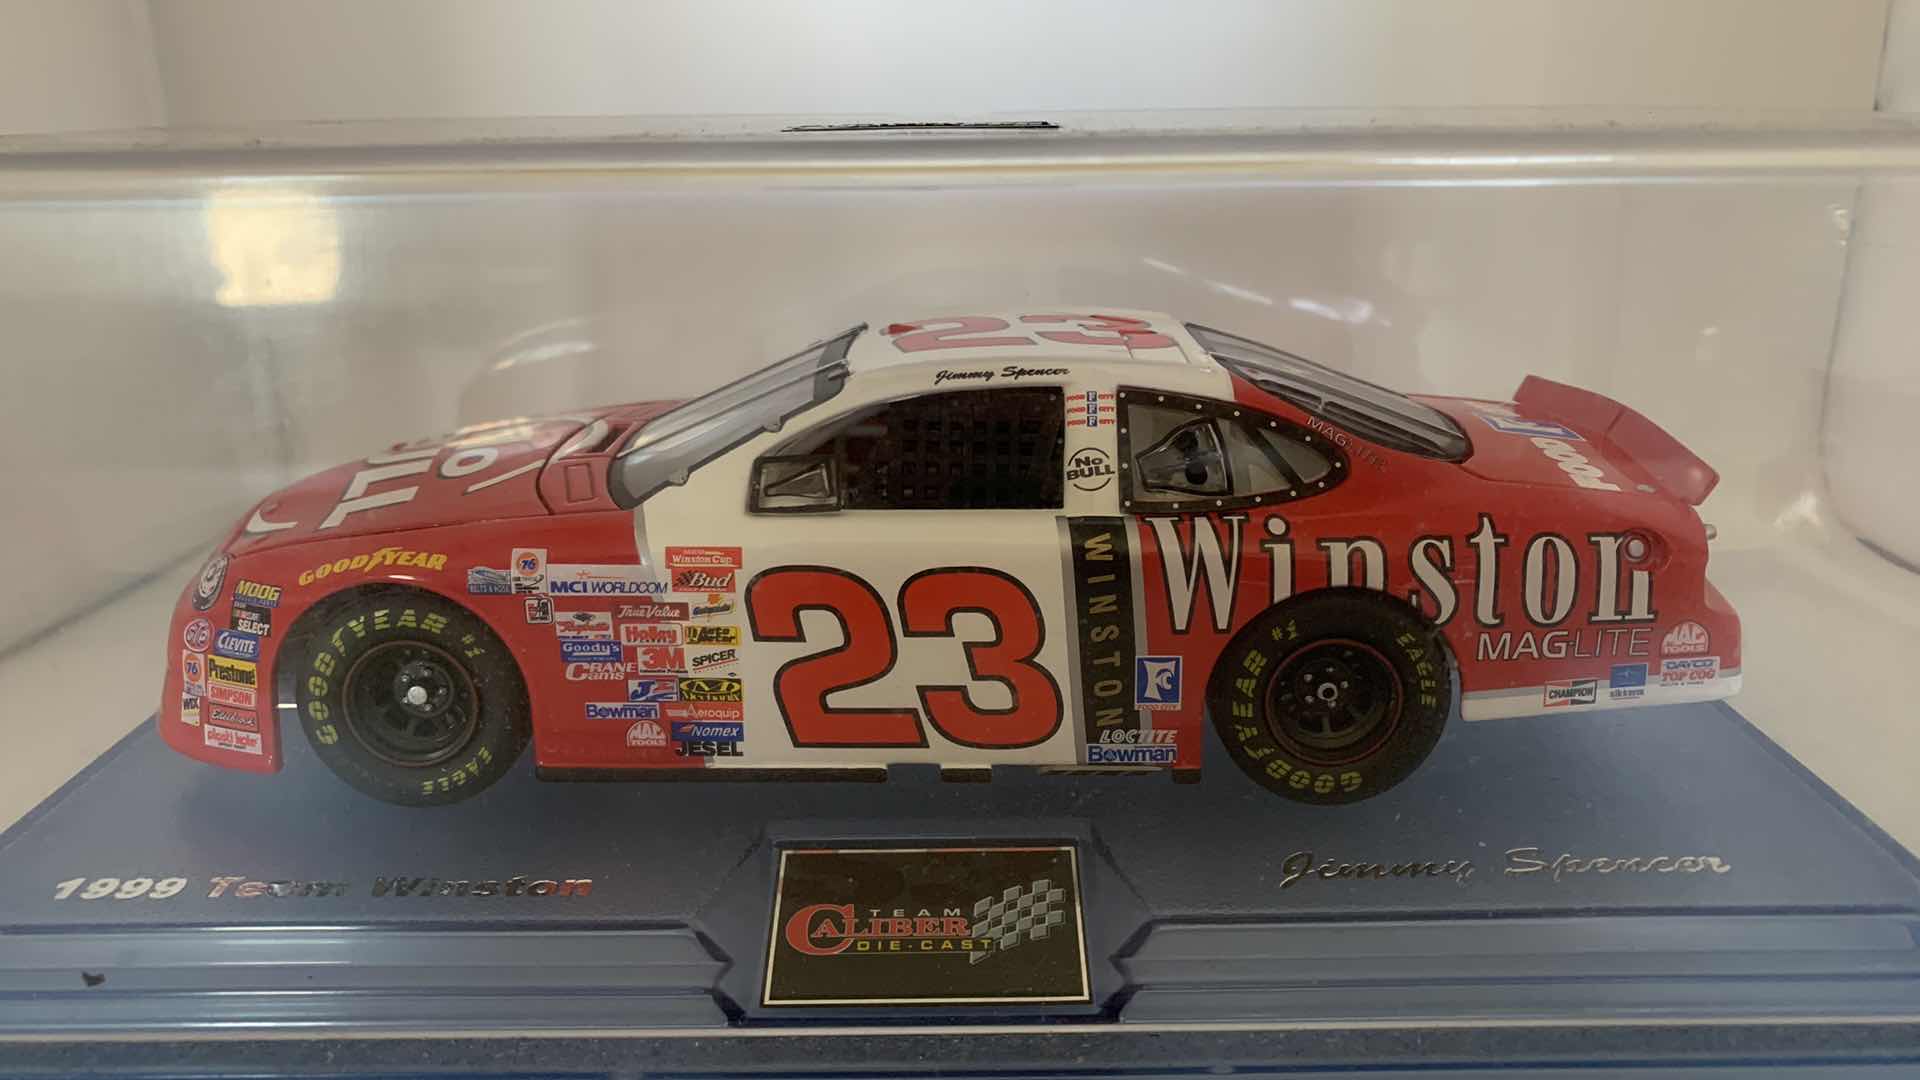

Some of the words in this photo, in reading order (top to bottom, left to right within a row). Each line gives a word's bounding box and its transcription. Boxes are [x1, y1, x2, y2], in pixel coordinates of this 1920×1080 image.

[879, 313, 1180, 353] 23
[934, 369, 995, 386] Jimmy
[1000, 365, 1072, 381] Spencer
[1074, 456, 1103, 468] No
[1066, 465, 1116, 480] BULL
[298, 547, 448, 586] GOODYEAR
[520, 558, 537, 571] 76
[672, 554, 711, 564] Winston
[688, 571, 735, 588] Bud
[1144, 511, 1658, 635] Winston
[235, 580, 282, 601] MOOG
[550, 581, 587, 593] MCI
[590, 581, 668, 594] WORLDCOM
[646, 604, 681, 618] Value
[237, 619, 270, 636] SELECT
[1084, 532, 1124, 727] WINSTON
[218, 631, 257, 654] CLEVITE
[562, 642, 620, 656] Goody's
[642, 646, 685, 670] 3M
[692, 648, 737, 668] SPICER
[743, 564, 1064, 751] 23
[186, 662, 199, 675] 76
[208, 657, 256, 686] Prestone
[308, 608, 449, 745] GOODYEAR
[1662, 671, 1689, 682] TOP
[210, 686, 253, 705] SIMPSON
[1548, 687, 1594, 700] CHAMPION
[586, 703, 658, 719] Bowman
[686, 703, 740, 719] Aeroquip
[691, 726, 740, 738] Nomex
[1100, 729, 1178, 744] LOCTITE
[673, 741, 744, 756] JESEL
[1087, 745, 1178, 761] Bowman
[421, 746, 494, 796] EAGLE
[1279, 851, 1478, 889] Jimmy
[1504, 847, 1731, 883] Spencer
[53, 876, 188, 900] 1999
[206, 875, 354, 899] Team
[368, 875, 594, 899] Winston
[870, 908, 961, 917] TEAM
[785, 903, 972, 956] CALIBER
[856, 938, 994, 951] DIE-CAST
